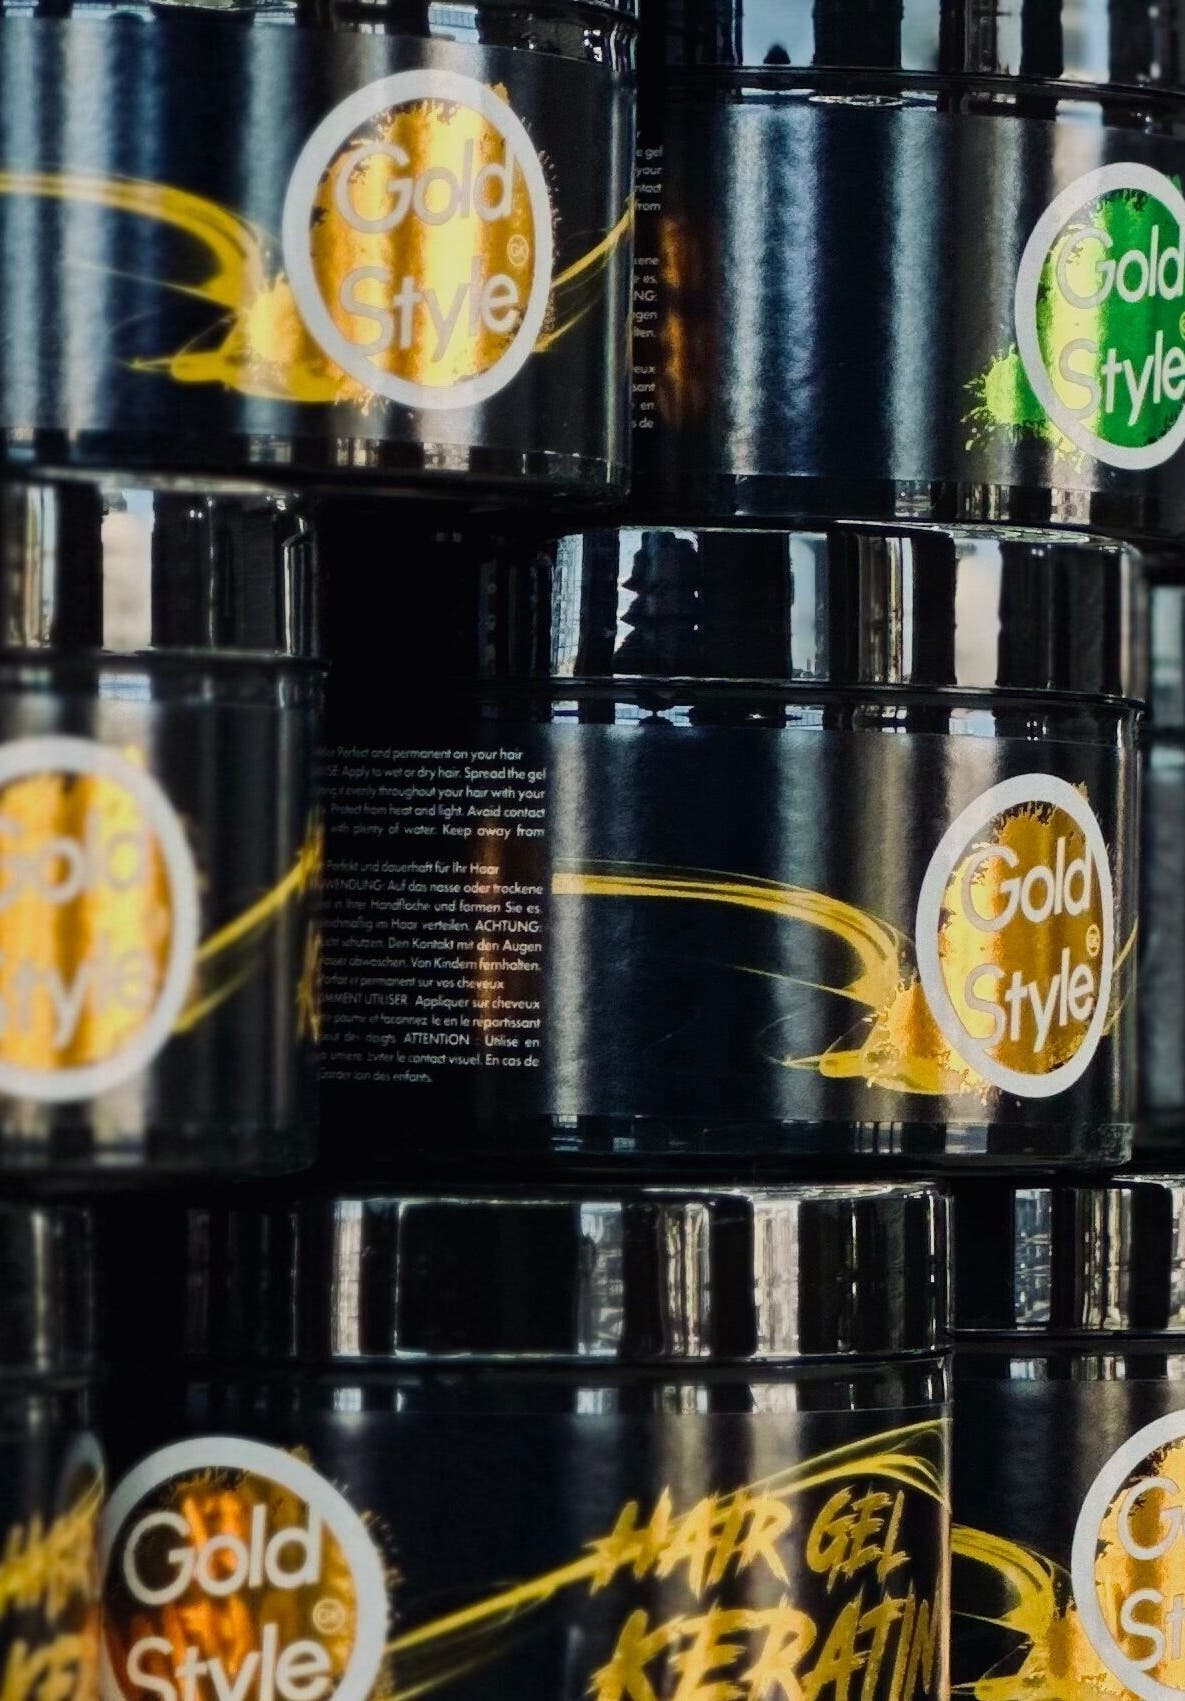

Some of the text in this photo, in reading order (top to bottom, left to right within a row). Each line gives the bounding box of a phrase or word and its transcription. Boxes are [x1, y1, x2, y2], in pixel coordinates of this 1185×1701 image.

[334, 138, 515, 234] Gold
[339, 256, 520, 362] Style
[392, 750, 451, 761] permanent
[453, 751, 468, 759] on
[471, 752, 497, 762] your
[500, 747, 524, 760] hair
[417, 766, 436, 780] dry
[464, 766, 506, 782] Spread
[507, 766, 526, 779] the
[527, 767, 546, 783] gel
[438, 788, 464, 800] your
[466, 784, 489, 797] hair
[490, 786, 516, 798] with
[518, 790, 545, 802] your
[414, 804, 435, 816] and
[467, 804, 501, 817] Avoid
[503, 807, 545, 818] contact
[388, 822, 400, 834] of
[443, 823, 472, 839] Keep
[477, 827, 512, 840] away
[516, 823, 545, 837] from
[470, 862, 500, 875] Haar
[408, 880, 427, 892] das
[429, 884, 461, 893] nasse
[463, 881, 491, 894] oder
[492, 881, 544, 895] trockene
[961, 837, 1093, 932] Gold
[434, 900, 456, 912] und
[459, 898, 501, 913] formen
[505, 901, 523, 914] Sie
[391, 918, 418, 930] Haar
[411, 937, 454, 950] Kontakt
[476, 937, 500, 951] den
[502, 939, 542, 955] Augen
[410, 955, 433, 968] Von
[457, 975, 505, 989] cheveux
[415, 994, 469, 1011] Appliquer
[472, 999, 490, 1008] sur
[491, 995, 540, 1010] cheveux
[964, 948, 1095, 1053] Style
[443, 1017, 458, 1027] en
[524, 1038, 541, 1048] en
[485, 1053, 500, 1067] En
[502, 1056, 522, 1067] cas
[524, 1054, 540, 1068] de
[583, 1484, 910, 1600] HAIR GEL
[123, 1503, 323, 1607] Gold
[587, 1579, 942, 1701] KERATIN
[127, 1623, 334, 1701] Style
